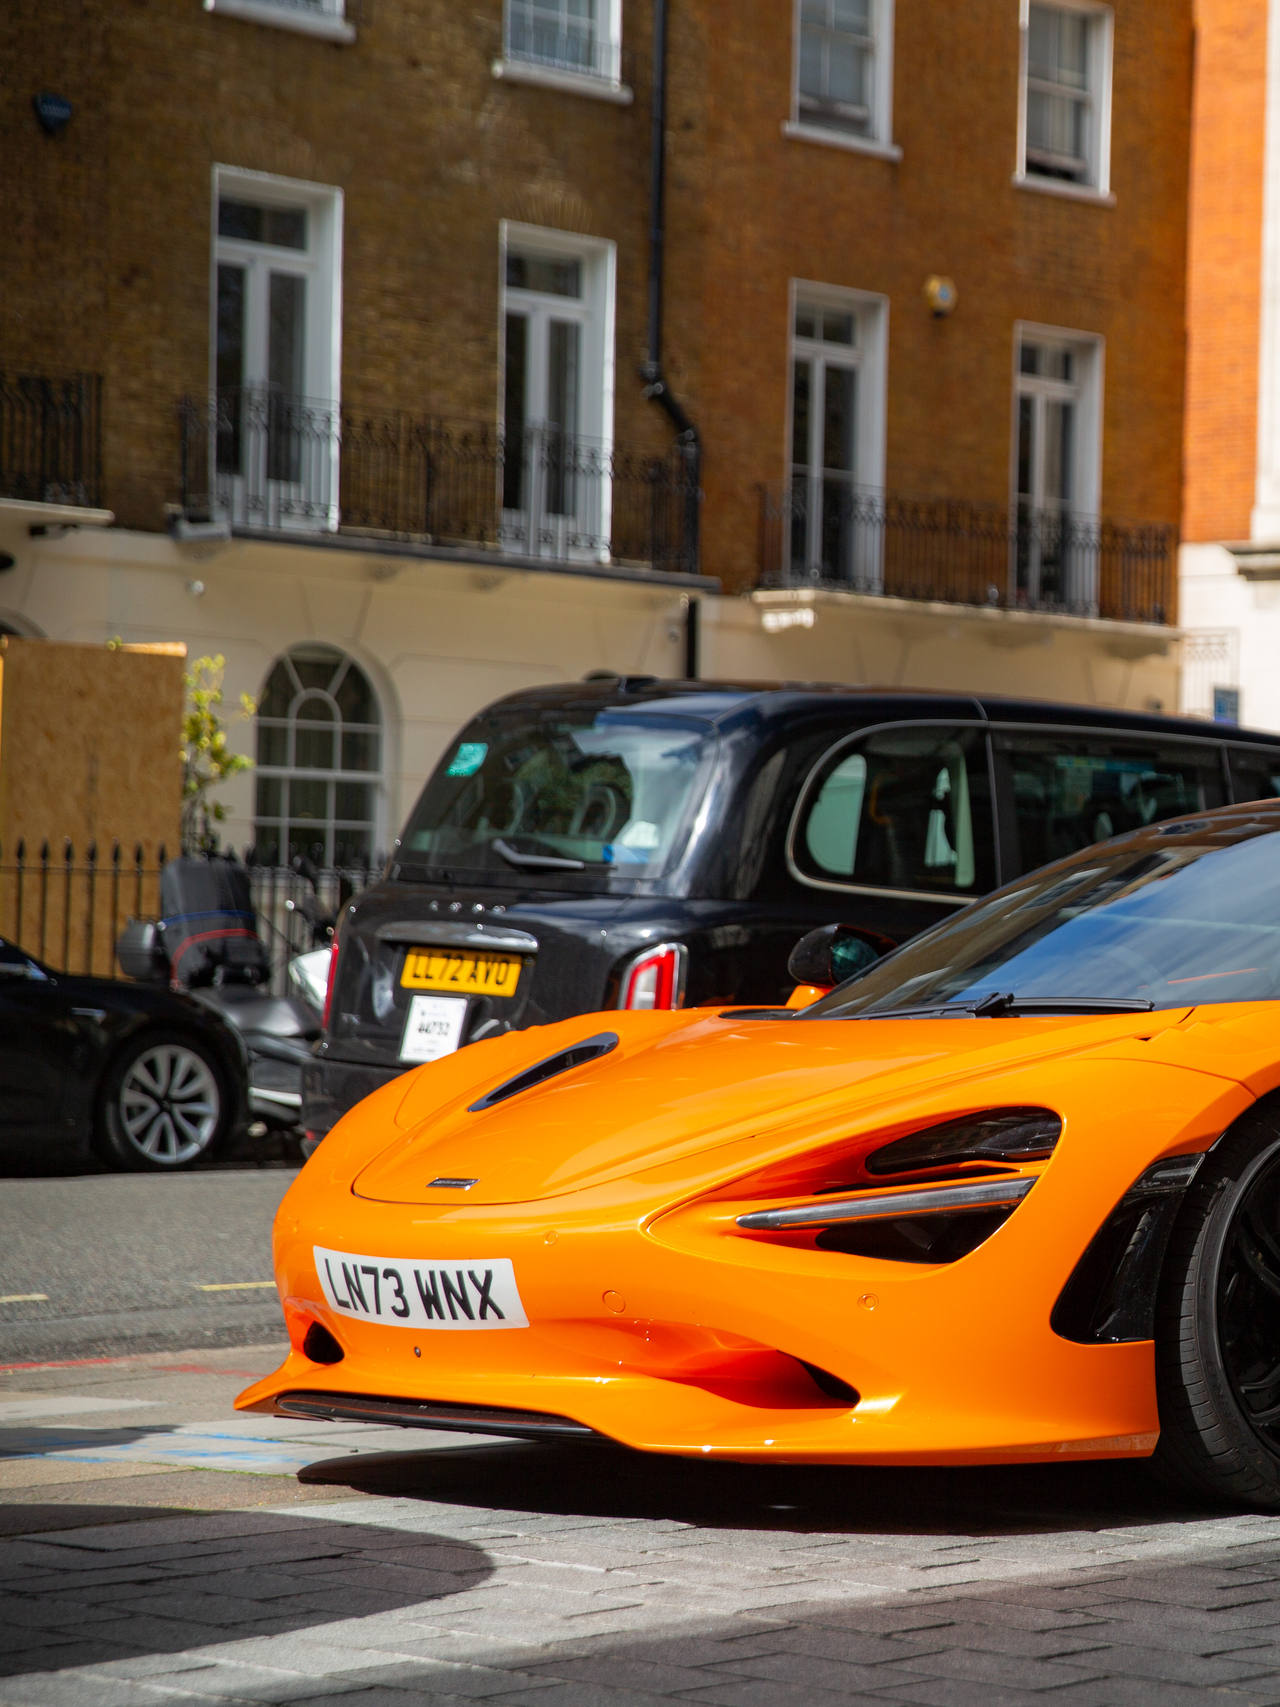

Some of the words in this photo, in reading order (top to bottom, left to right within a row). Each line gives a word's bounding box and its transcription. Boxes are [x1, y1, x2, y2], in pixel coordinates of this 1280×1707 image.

[413, 949, 464, 982] LL72
[324, 1257, 411, 1318] LN73
[413, 1269, 506, 1320] WNX
